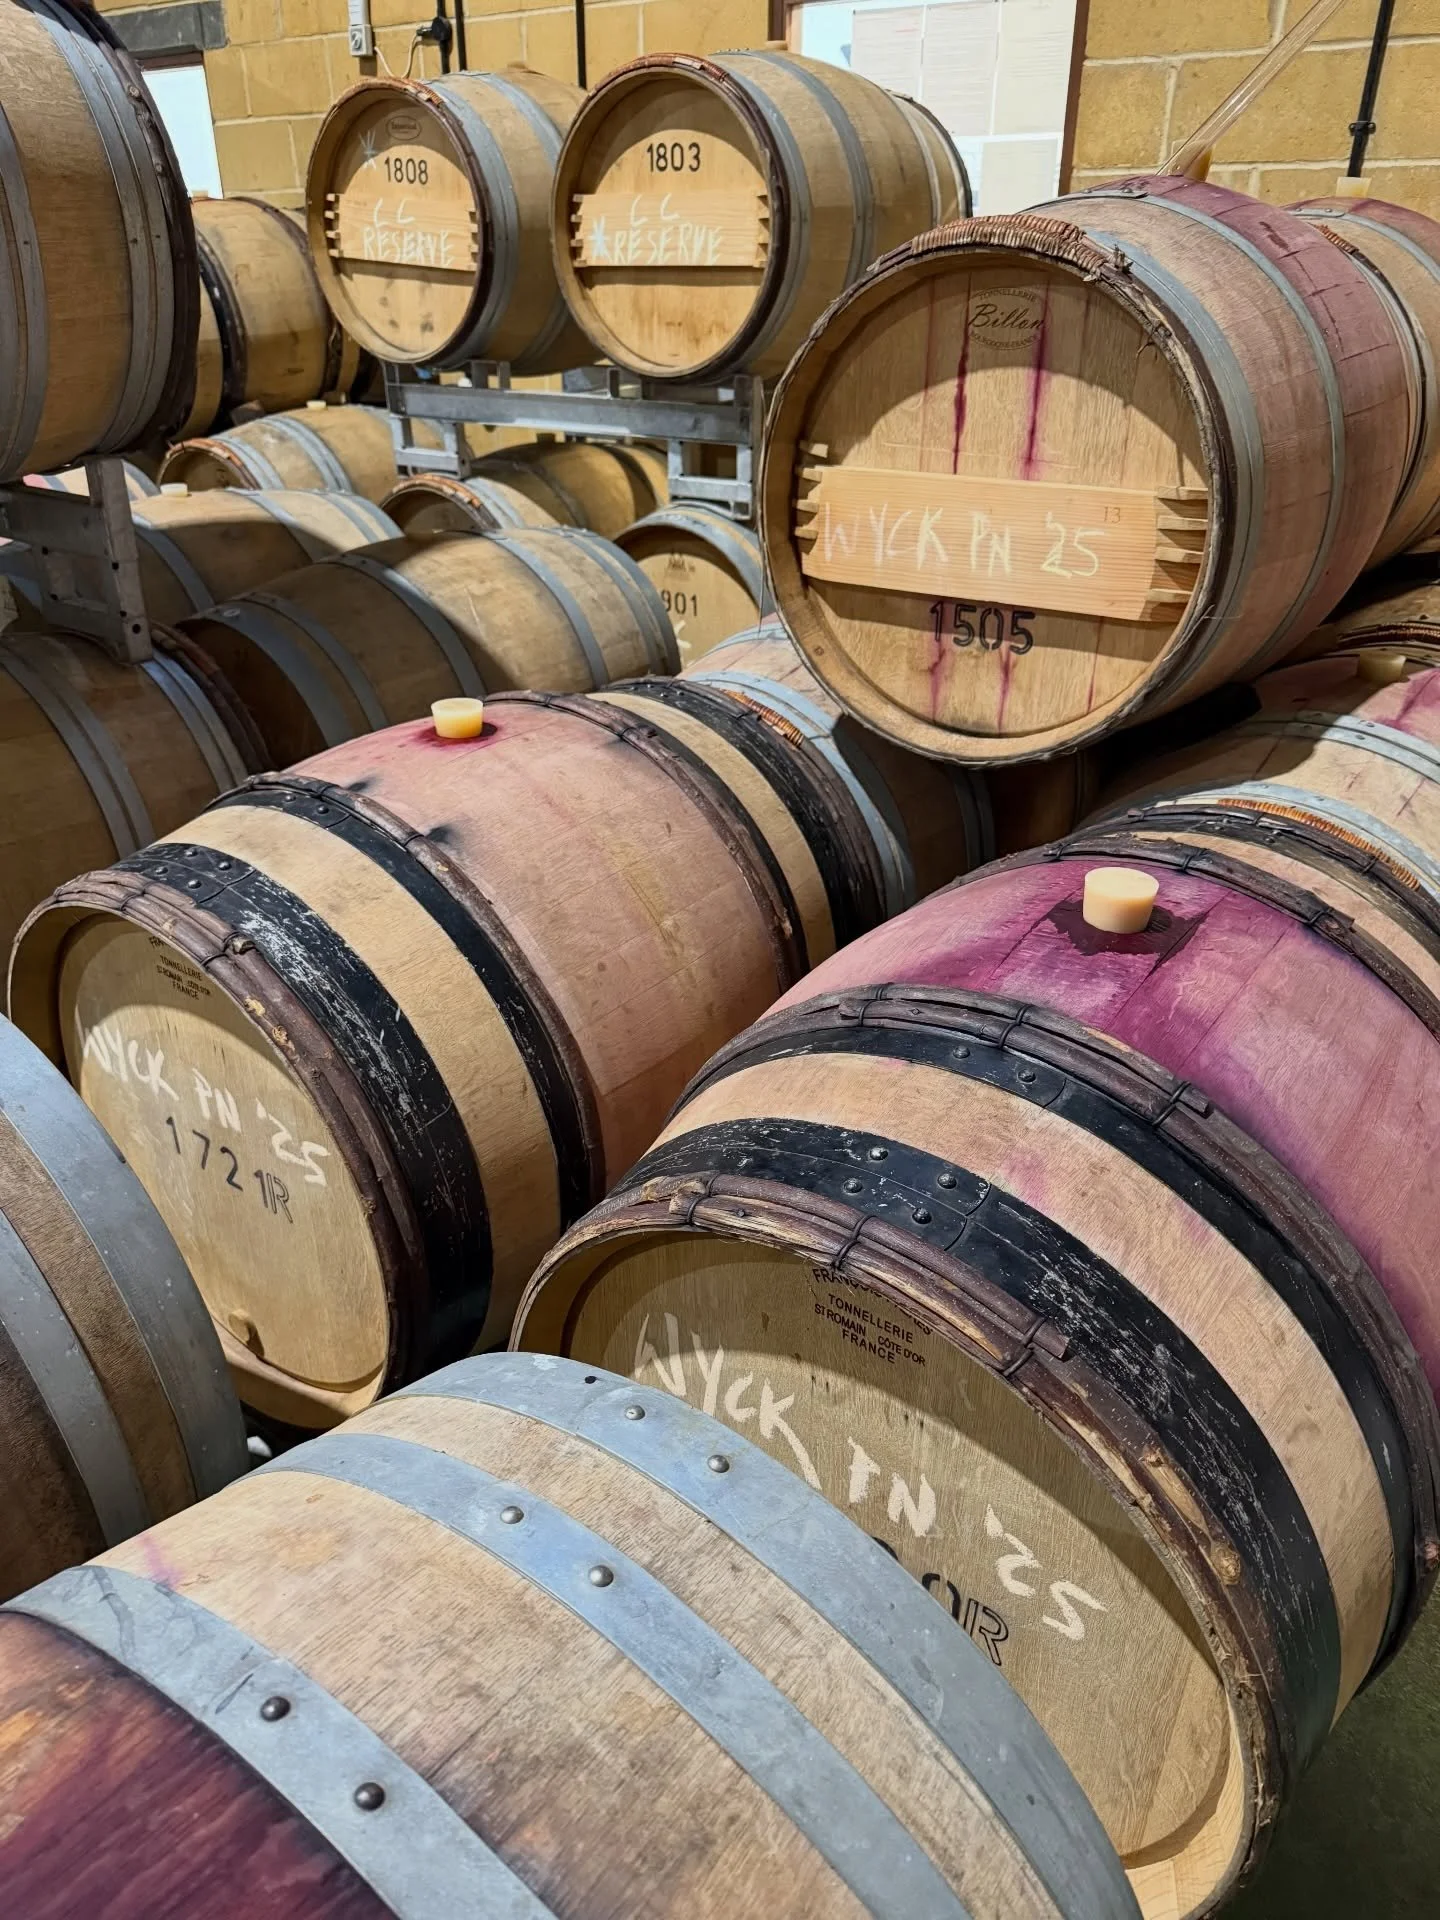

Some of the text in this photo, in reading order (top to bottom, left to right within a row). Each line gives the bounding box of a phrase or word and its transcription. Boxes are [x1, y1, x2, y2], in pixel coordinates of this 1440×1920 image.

[384, 157, 429, 185] 1808
[645, 142, 702, 173] 1803
[824, 502, 949, 572] WYCK
[970, 510, 1012, 578] PN
[929, 600, 1037, 656] 1505
[191, 1067, 242, 1134] PN
[827, 1293, 914, 1345] TONNELLERIE
[841, 1328, 896, 1365] FRANCE
